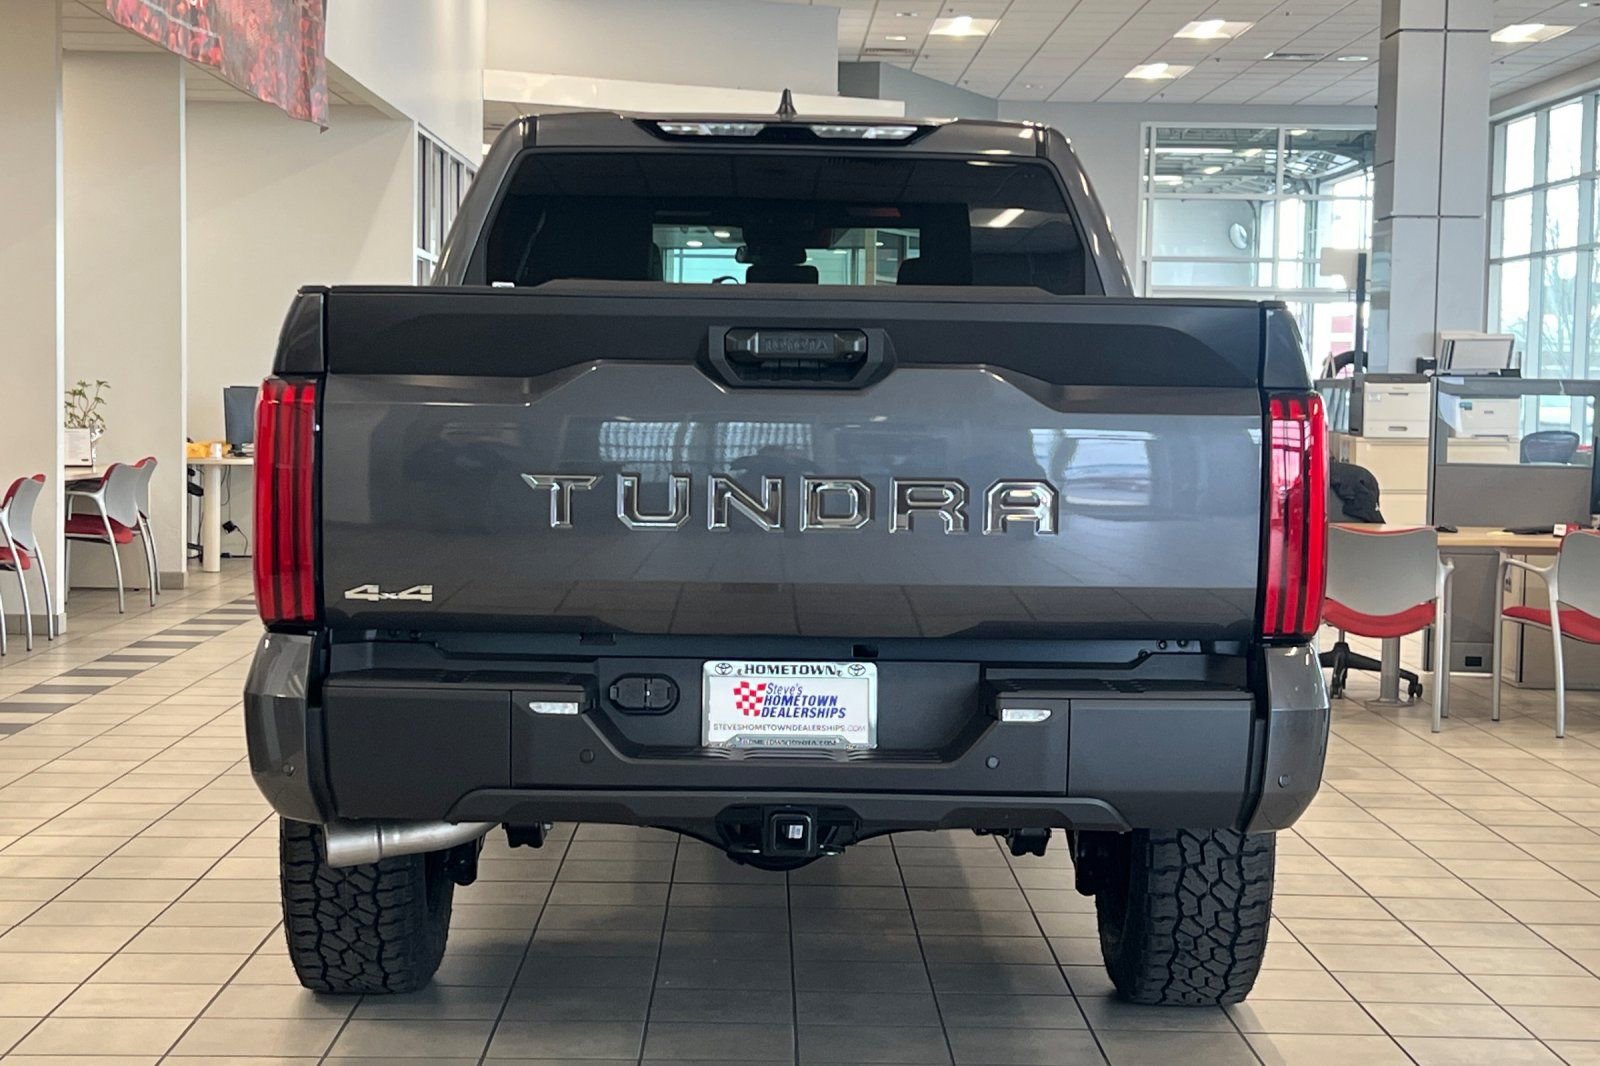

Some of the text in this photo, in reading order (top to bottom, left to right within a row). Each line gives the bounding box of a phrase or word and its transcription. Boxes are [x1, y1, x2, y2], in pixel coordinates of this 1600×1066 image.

[520, 472, 1060, 536] TUNDRA
[744, 663, 837, 676] HOMETOWN
[766, 682, 804, 696] Steve's
[763, 695, 839, 707] HOMETOWN
[760, 706, 847, 719] DEALERSHIPS
